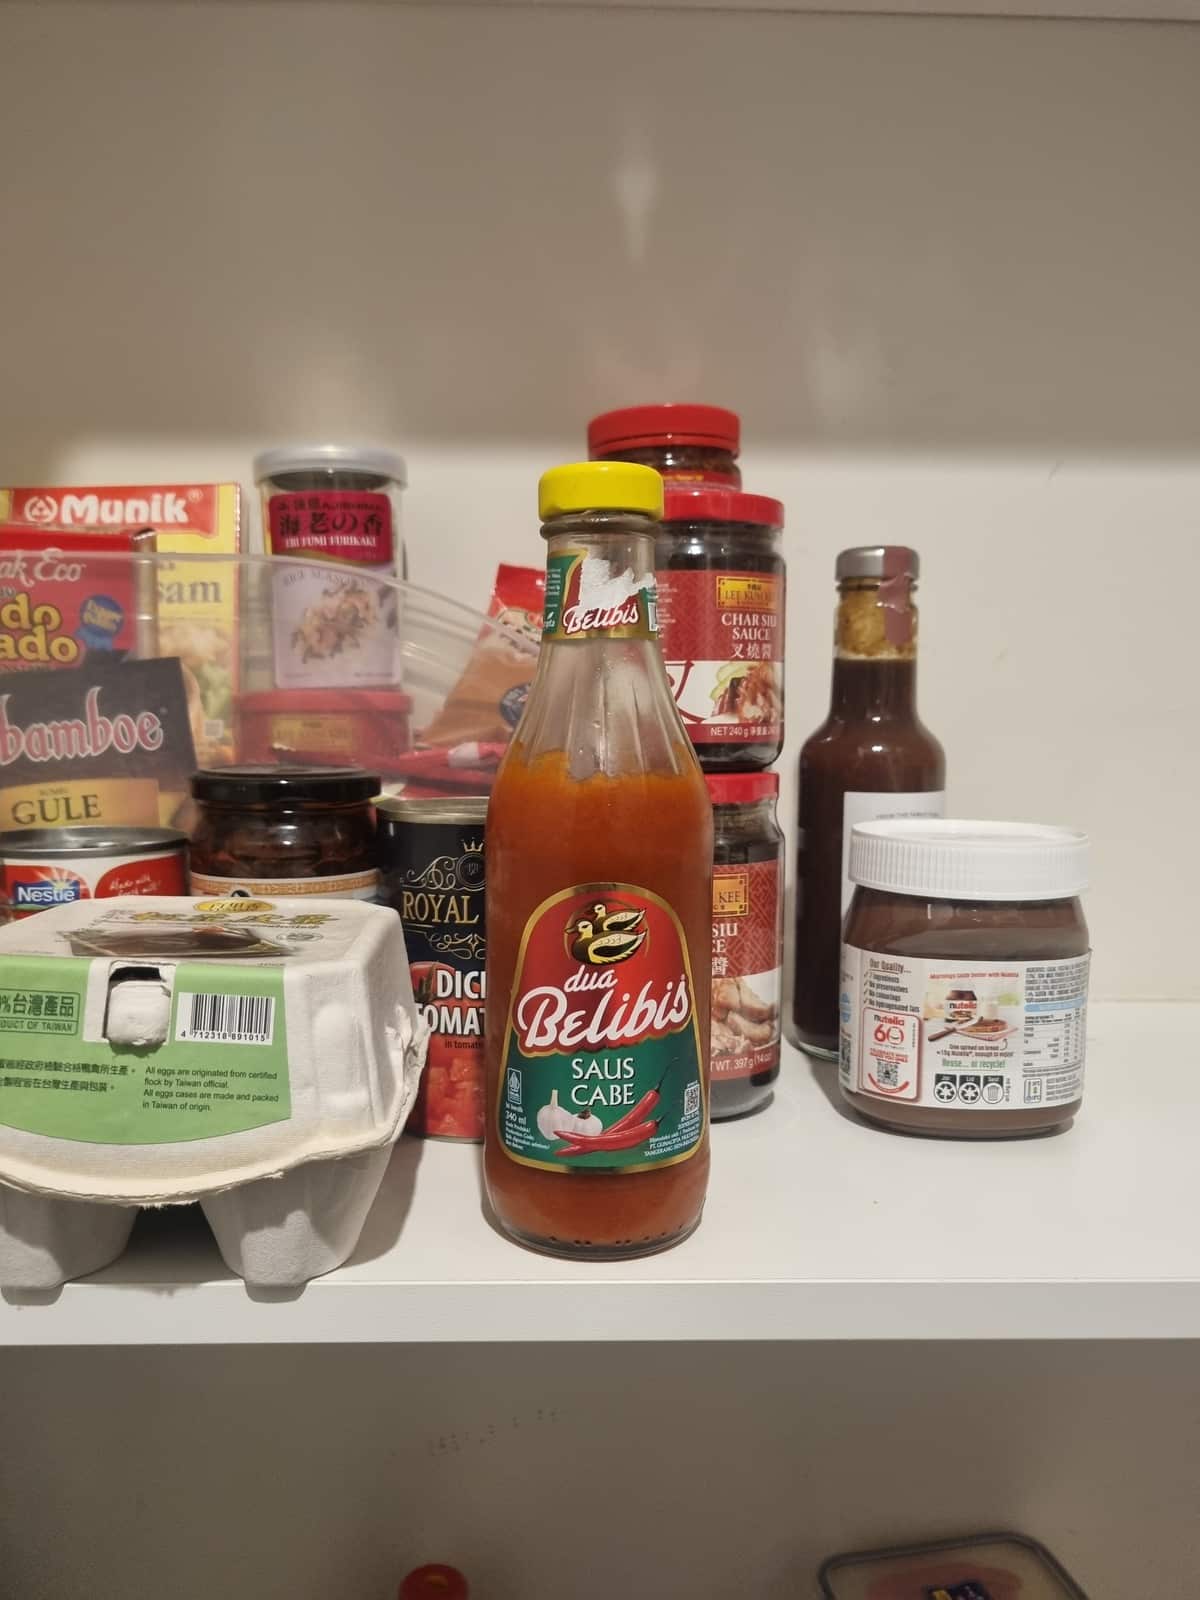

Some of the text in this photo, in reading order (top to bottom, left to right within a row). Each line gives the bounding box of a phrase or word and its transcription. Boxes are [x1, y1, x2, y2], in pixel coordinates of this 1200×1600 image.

[61, 493, 189, 524] Munik
[33, 547, 87, 582] Eco
[721, 612, 758, 626] CHAR
[732, 626, 770, 641] SAUCE
[710, 727, 728, 736] NET
[729, 727, 742, 736] 240
[11, 795, 102, 824] GULE
[402, 890, 480, 925] ROYAL
[564, 964, 618, 993] dua
[874, 1014, 904, 1026] nutella
[180, 1030, 186, 1038] 4
[146, 1066, 155, 1074] All
[157, 1068, 175, 1076] eggs
[192, 1069, 228, 1078] originated
[230, 1070, 246, 1078] from
[249, 1071, 277, 1079] certified
[571, 1058, 635, 1080] SAUS
[164, 1079, 172, 1087] by
[176, 1079, 201, 1087] Taiwan
[571, 1083, 636, 1106] CABE
[152, 1101, 178, 1109] Taiwan
[180, 1102, 188, 1110] of
[506, 1111, 517, 1121] 340
